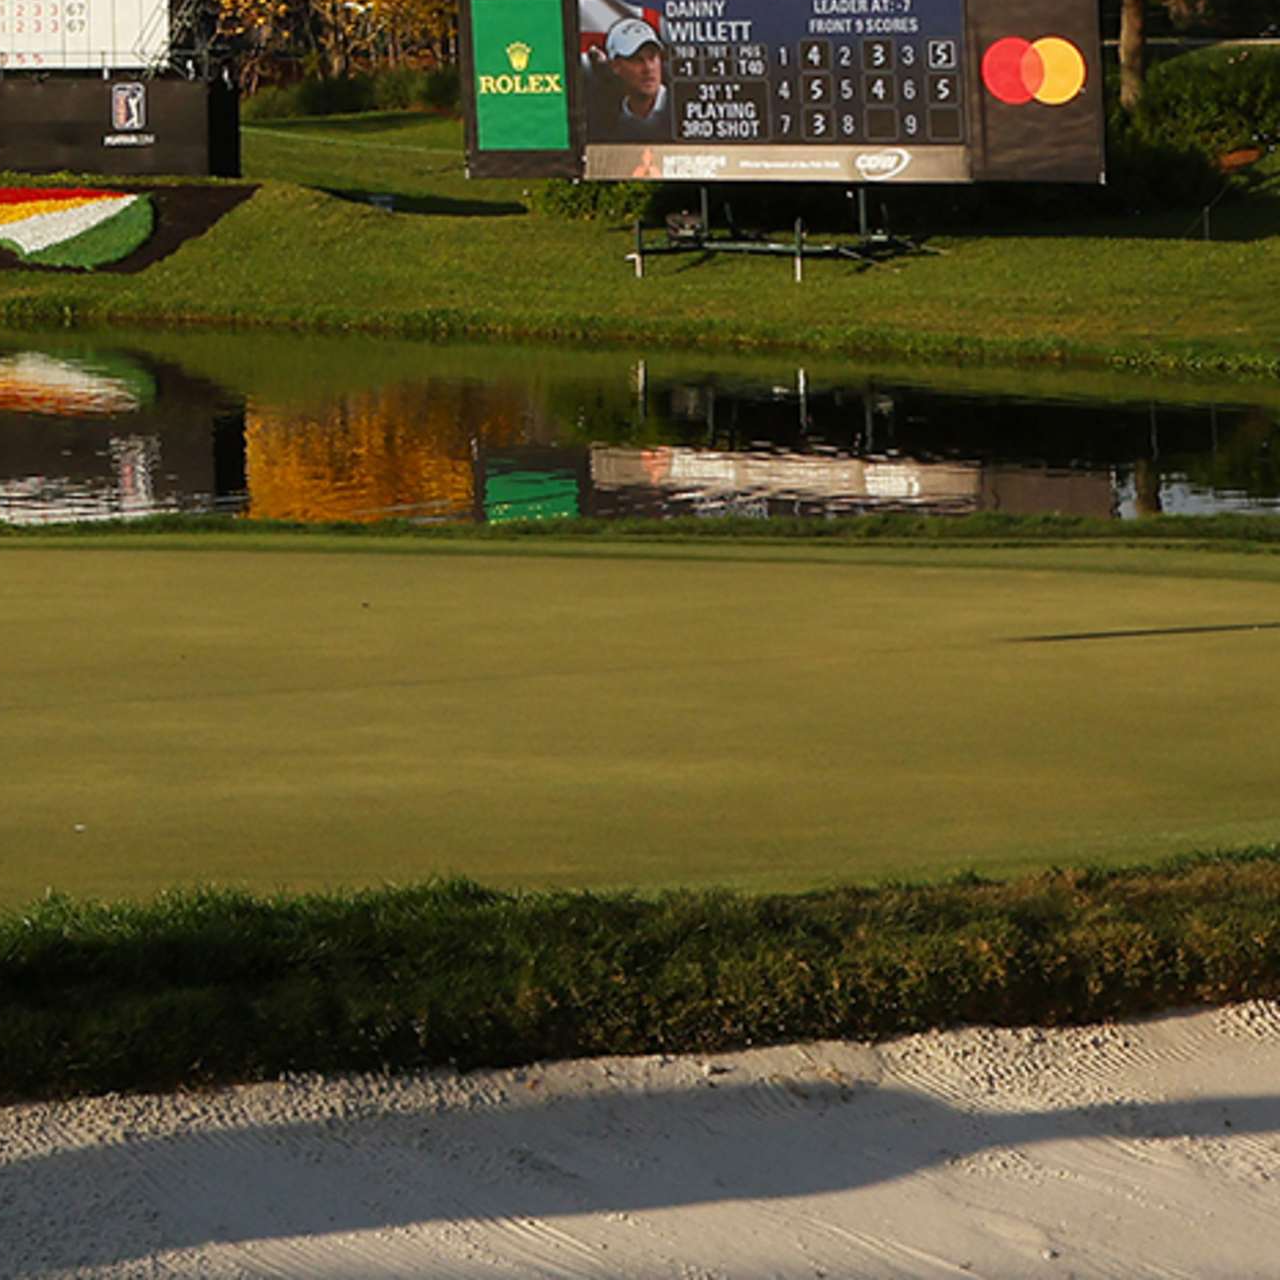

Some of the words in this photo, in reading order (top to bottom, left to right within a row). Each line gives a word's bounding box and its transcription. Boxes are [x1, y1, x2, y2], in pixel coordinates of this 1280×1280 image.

[66, 3, 85, 16] 67
[665, 0, 726, 17] DANNY
[67, 20, 86, 33] 67
[667, 21, 752, 41] WILLETT
[809, 19, 852, 33] FRONT
[855, 18, 864, 33] 9
[866, 17, 919, 33] SCORES
[779, 46, 788, 65] 1
[808, 45, 820, 66] 4
[840, 46, 851, 66] 2
[872, 44, 885, 66] 3
[902, 46, 914, 65] 3
[936, 43, 947, 65] 5
[680, 61, 692, 75] -1
[712, 61, 725, 75] -1
[480, 74, 561, 94] ROLEX
[778, 81, 790, 99] 4
[811, 79, 823, 99] 5
[841, 79, 852, 99] 5
[872, 79, 885, 100] 4
[904, 80, 915, 99] 6
[937, 78, 949, 99] 5
[687, 102, 756, 119] PLAYING
[682, 120, 713, 137] 3RD
[716, 120, 759, 136] SHOT
[781, 115, 790, 134] 7
[813, 114, 826, 134] 3
[843, 114, 854, 134] 8
[905, 115, 916, 134] 9
